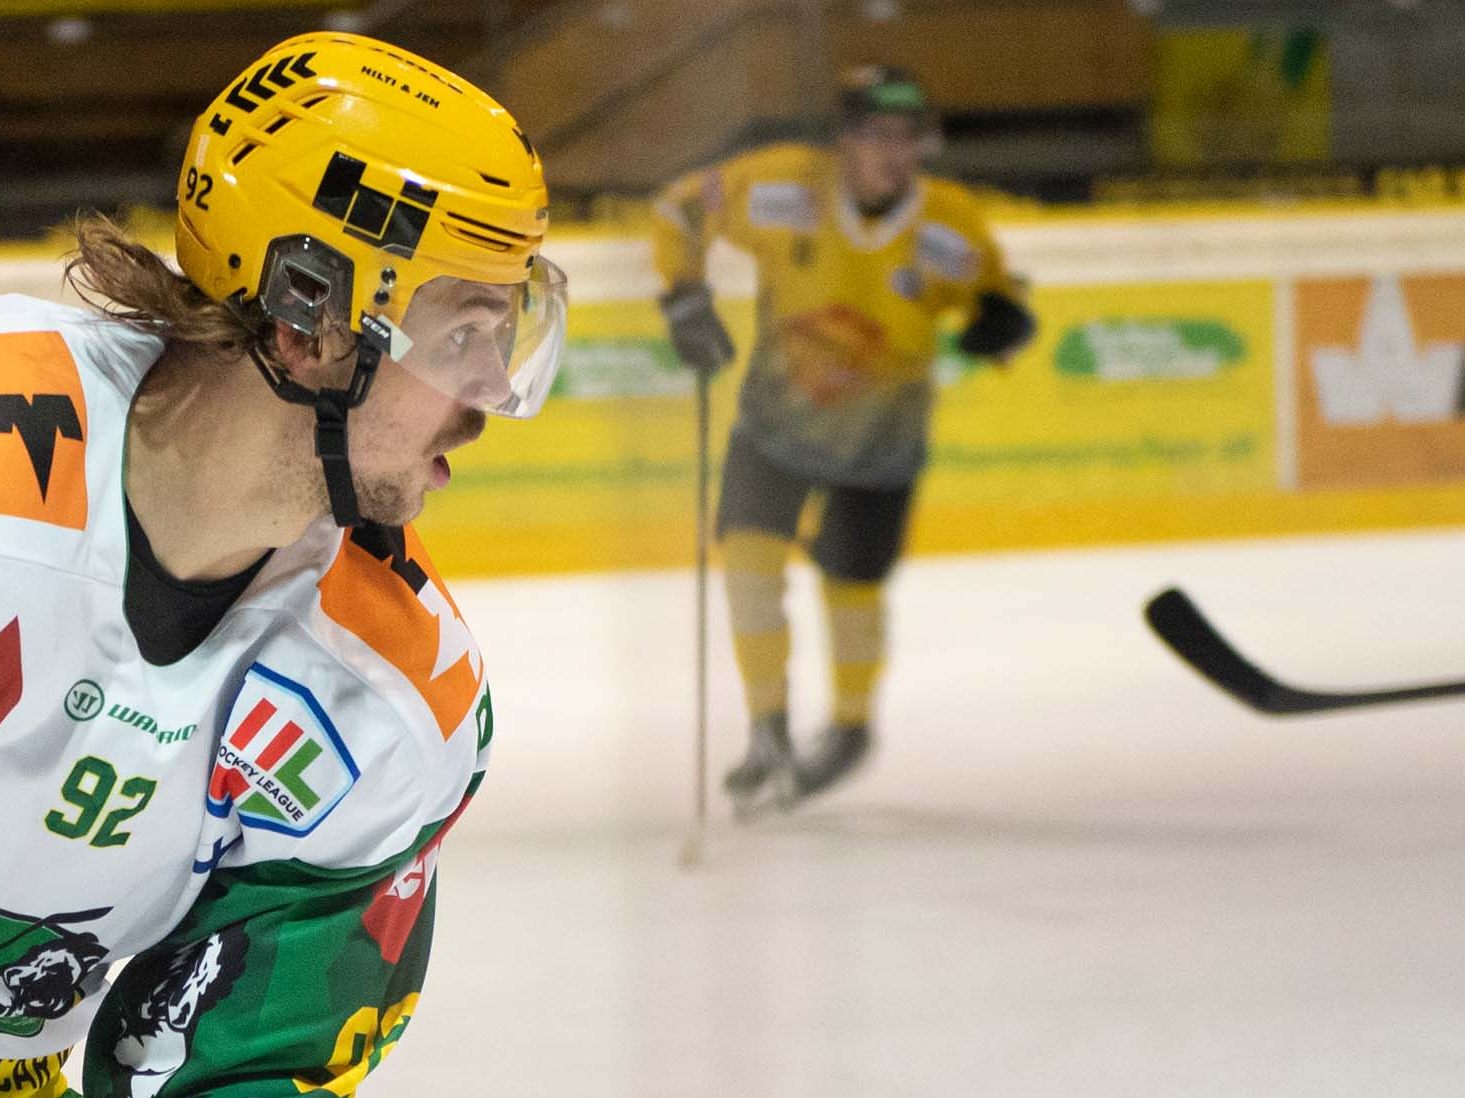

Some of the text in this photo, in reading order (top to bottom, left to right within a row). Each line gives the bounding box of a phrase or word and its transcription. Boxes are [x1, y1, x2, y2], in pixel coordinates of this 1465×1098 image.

[361, 66, 396, 86] HILTI
[400, 84, 410, 94] &
[185, 166, 213, 211] 92
[45, 755, 158, 847] 92
[256, 775, 304, 823] LEAGUE
